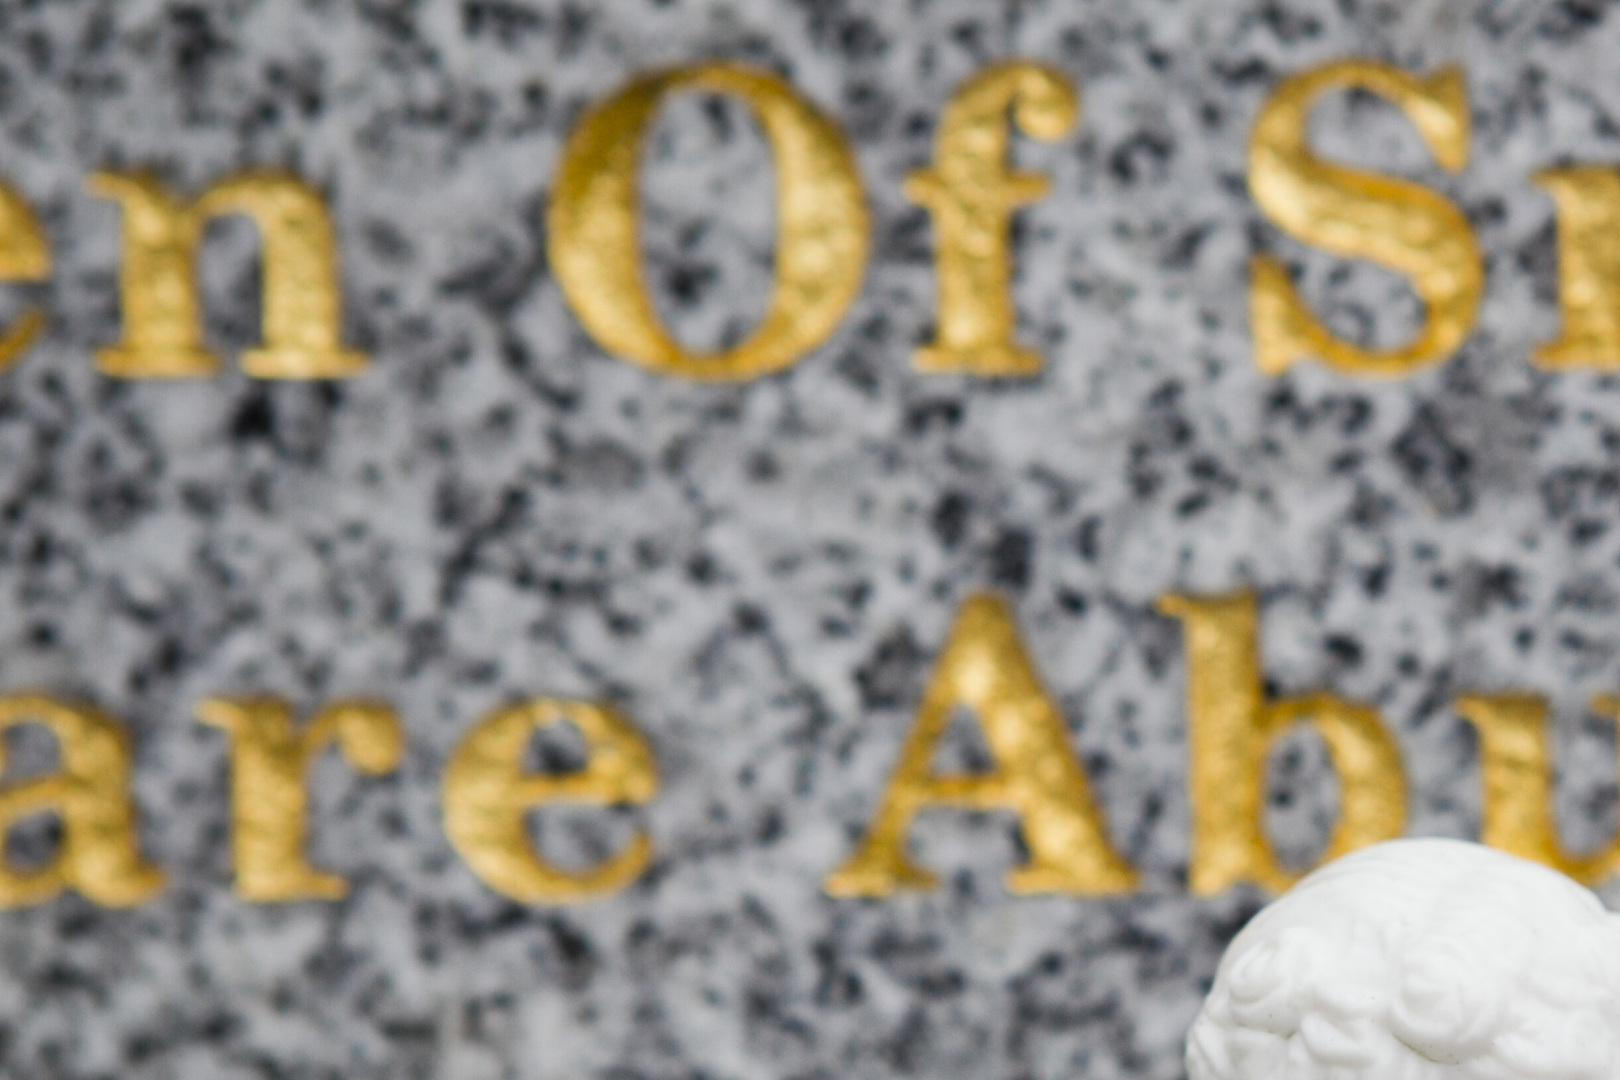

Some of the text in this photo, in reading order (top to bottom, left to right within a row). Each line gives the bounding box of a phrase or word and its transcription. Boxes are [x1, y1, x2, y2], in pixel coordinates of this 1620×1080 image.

[0, 170, 369, 381] n
[545, 60, 1080, 383] Of
[0, 692, 660, 908] are
